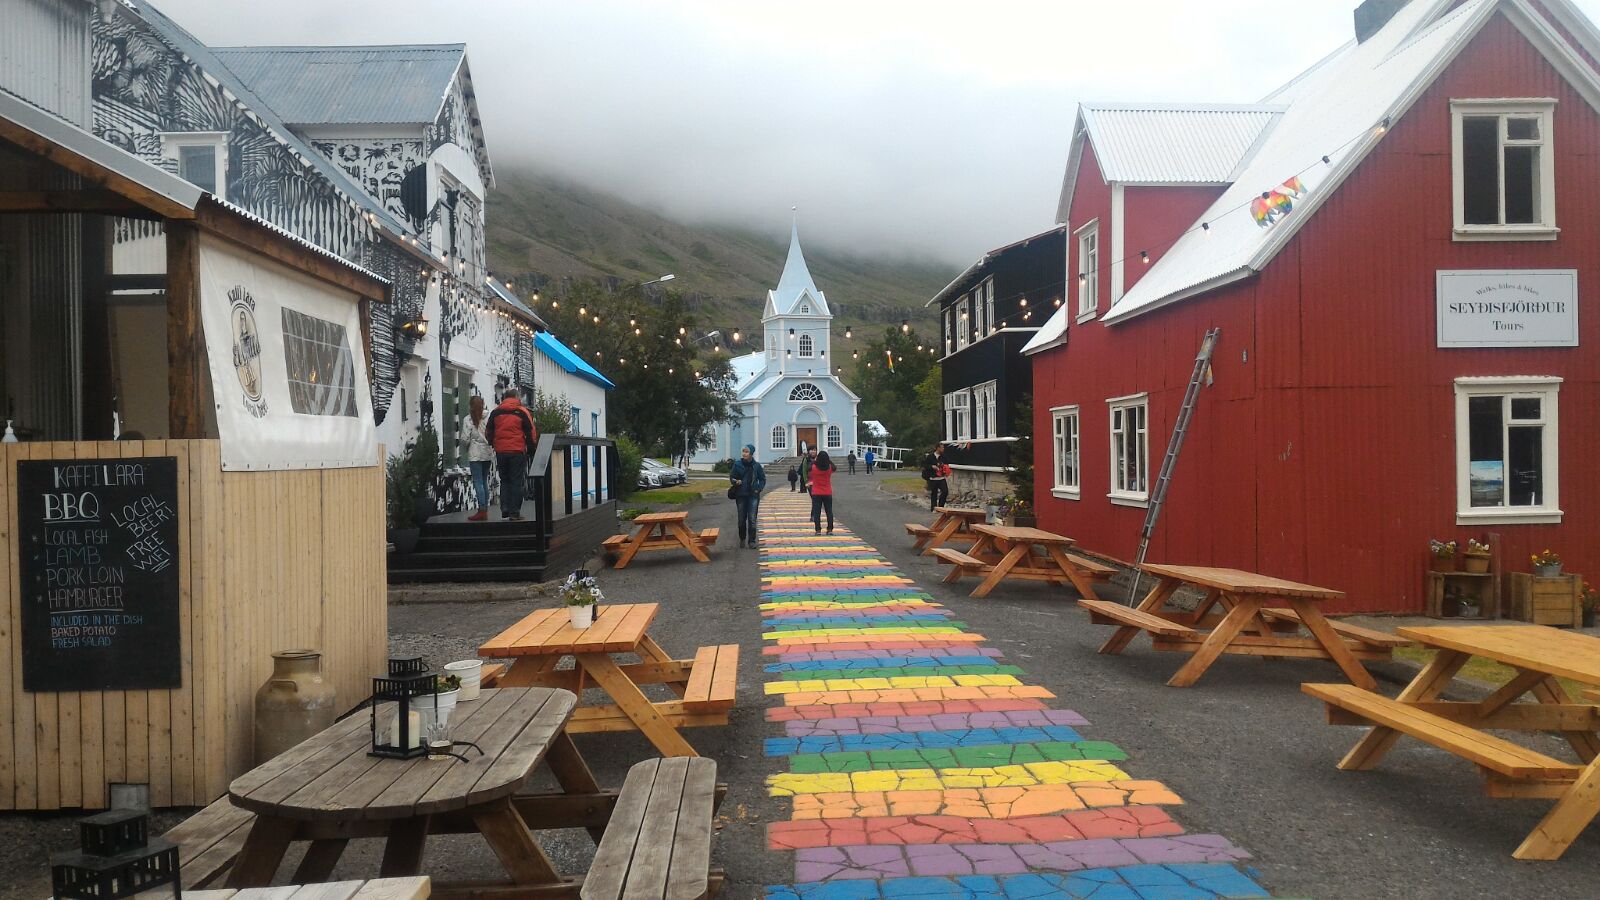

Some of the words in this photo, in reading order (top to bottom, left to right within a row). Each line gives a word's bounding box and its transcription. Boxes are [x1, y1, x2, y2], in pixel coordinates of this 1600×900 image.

[1449, 300, 1565, 313] SEYÐISFJÖRÐUR
[1492, 320, 1524, 330] Tours
[54, 464, 99, 488] KAFFI
[42, 491, 99, 520] BBQ
[110, 494, 166, 527] LOCAL
[127, 506, 175, 538] BEER!
[44, 527, 81, 545] LOCAL
[85, 529, 108, 545] FISH
[126, 531, 164, 560] FREE
[46, 546, 101, 565] LAMB
[133, 548, 170, 570] WIFI
[46, 567, 85, 587] PORK
[89, 566, 124, 583] LOIN
[48, 586, 124, 608] HAMBURGER
[51, 616, 88, 626] INCLUDED
[92, 615, 100, 625] IN
[104, 615, 120, 625] THE
[123, 615, 143, 624] DISH
[51, 626, 80, 637] BAKED
[83, 625, 116, 635] POTATO
[52, 637, 80, 648] FRESH
[82, 636, 111, 647] SALAD
